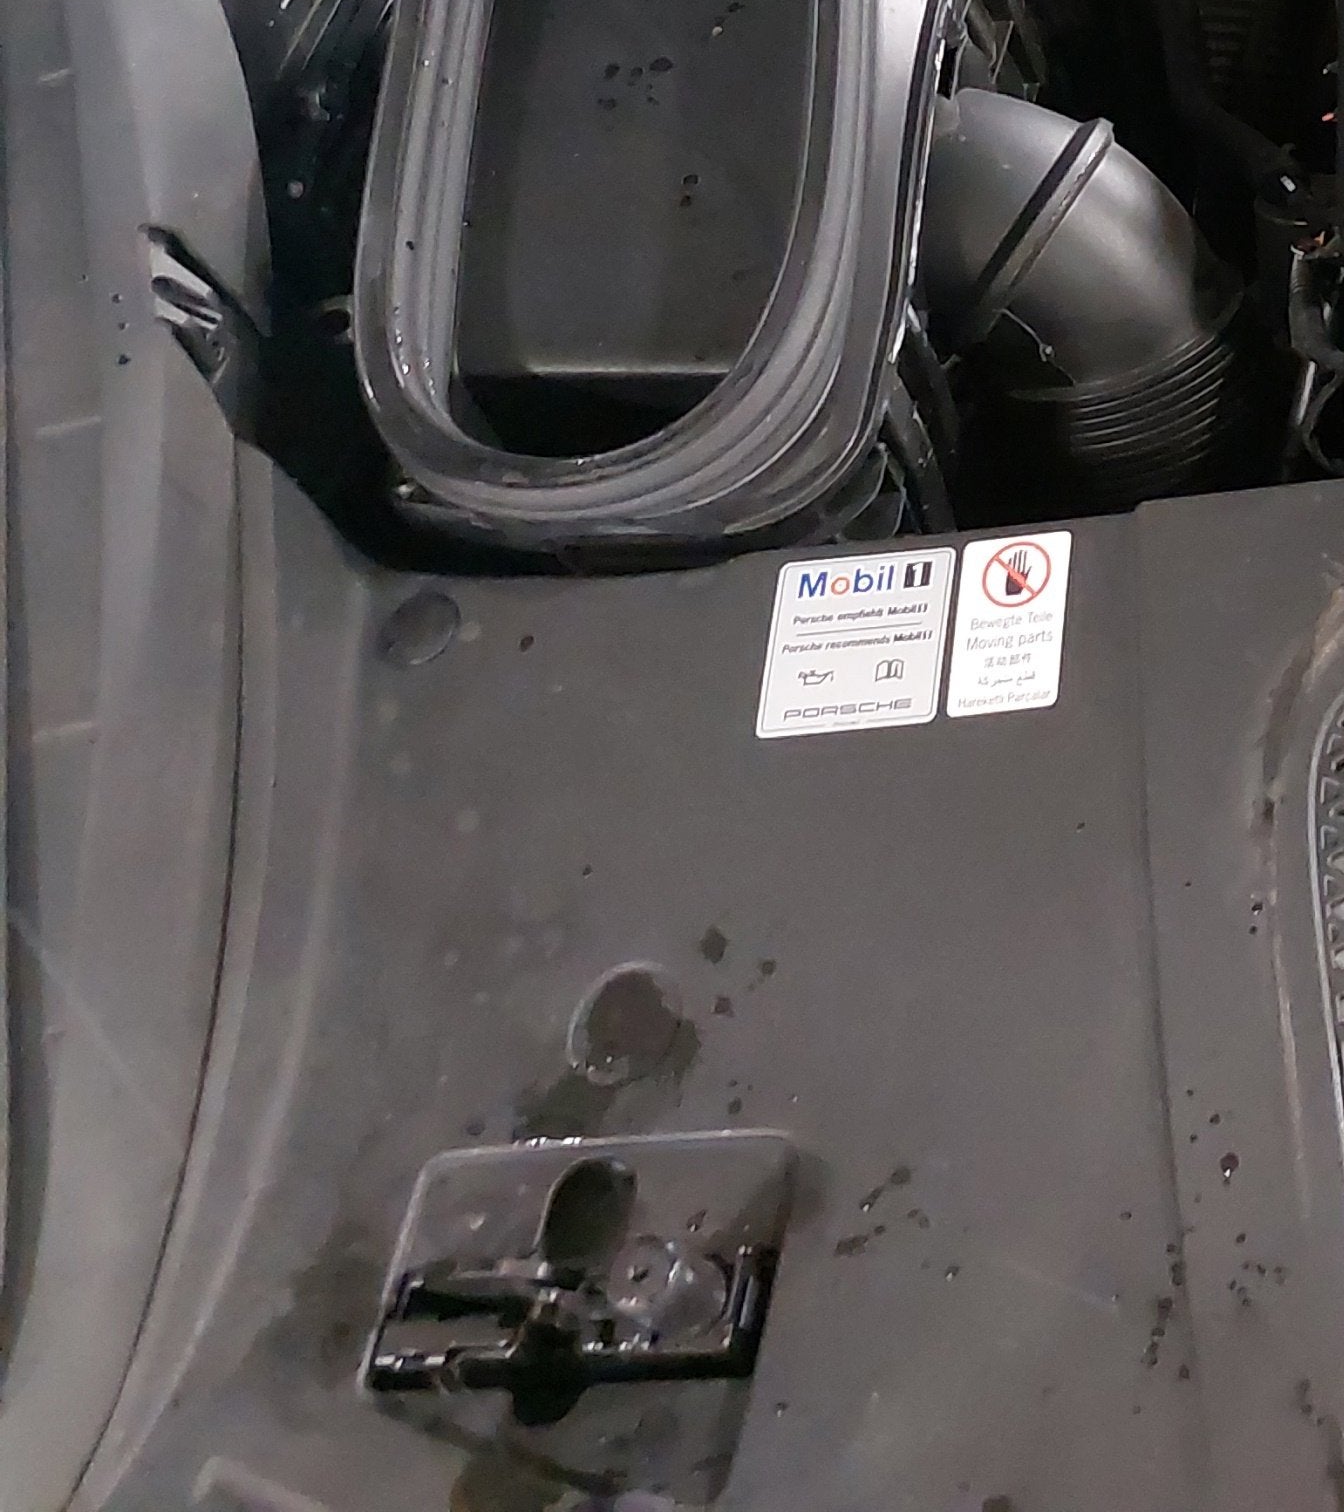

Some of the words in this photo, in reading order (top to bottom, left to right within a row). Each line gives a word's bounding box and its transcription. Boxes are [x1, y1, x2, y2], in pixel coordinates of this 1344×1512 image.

[798, 564, 894, 598] Mobil
[793, 613, 834, 625] Porsche
[782, 642, 823, 655] Porsche
[825, 635, 890, 650] recommends
[965, 635, 1014, 651] Moving
[1018, 630, 1053, 647] parts
[784, 698, 912, 722] PORSCHE
